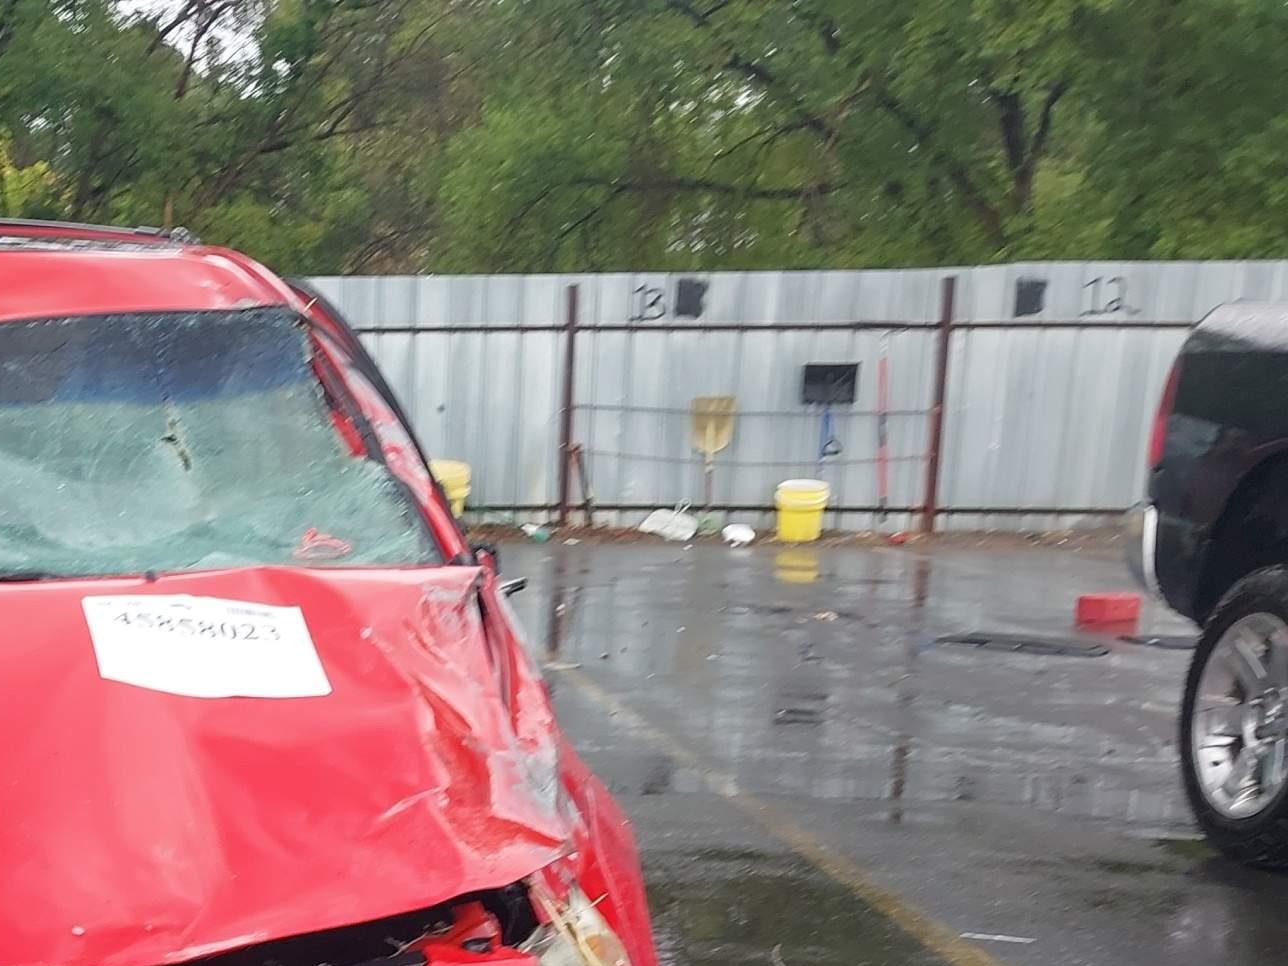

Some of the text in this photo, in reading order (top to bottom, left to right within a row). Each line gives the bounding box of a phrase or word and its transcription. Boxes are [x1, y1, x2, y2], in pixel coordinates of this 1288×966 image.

[629, 284, 667, 321] 13
[1078, 276, 1142, 317] 12
[113, 611, 281, 641] 45858023
